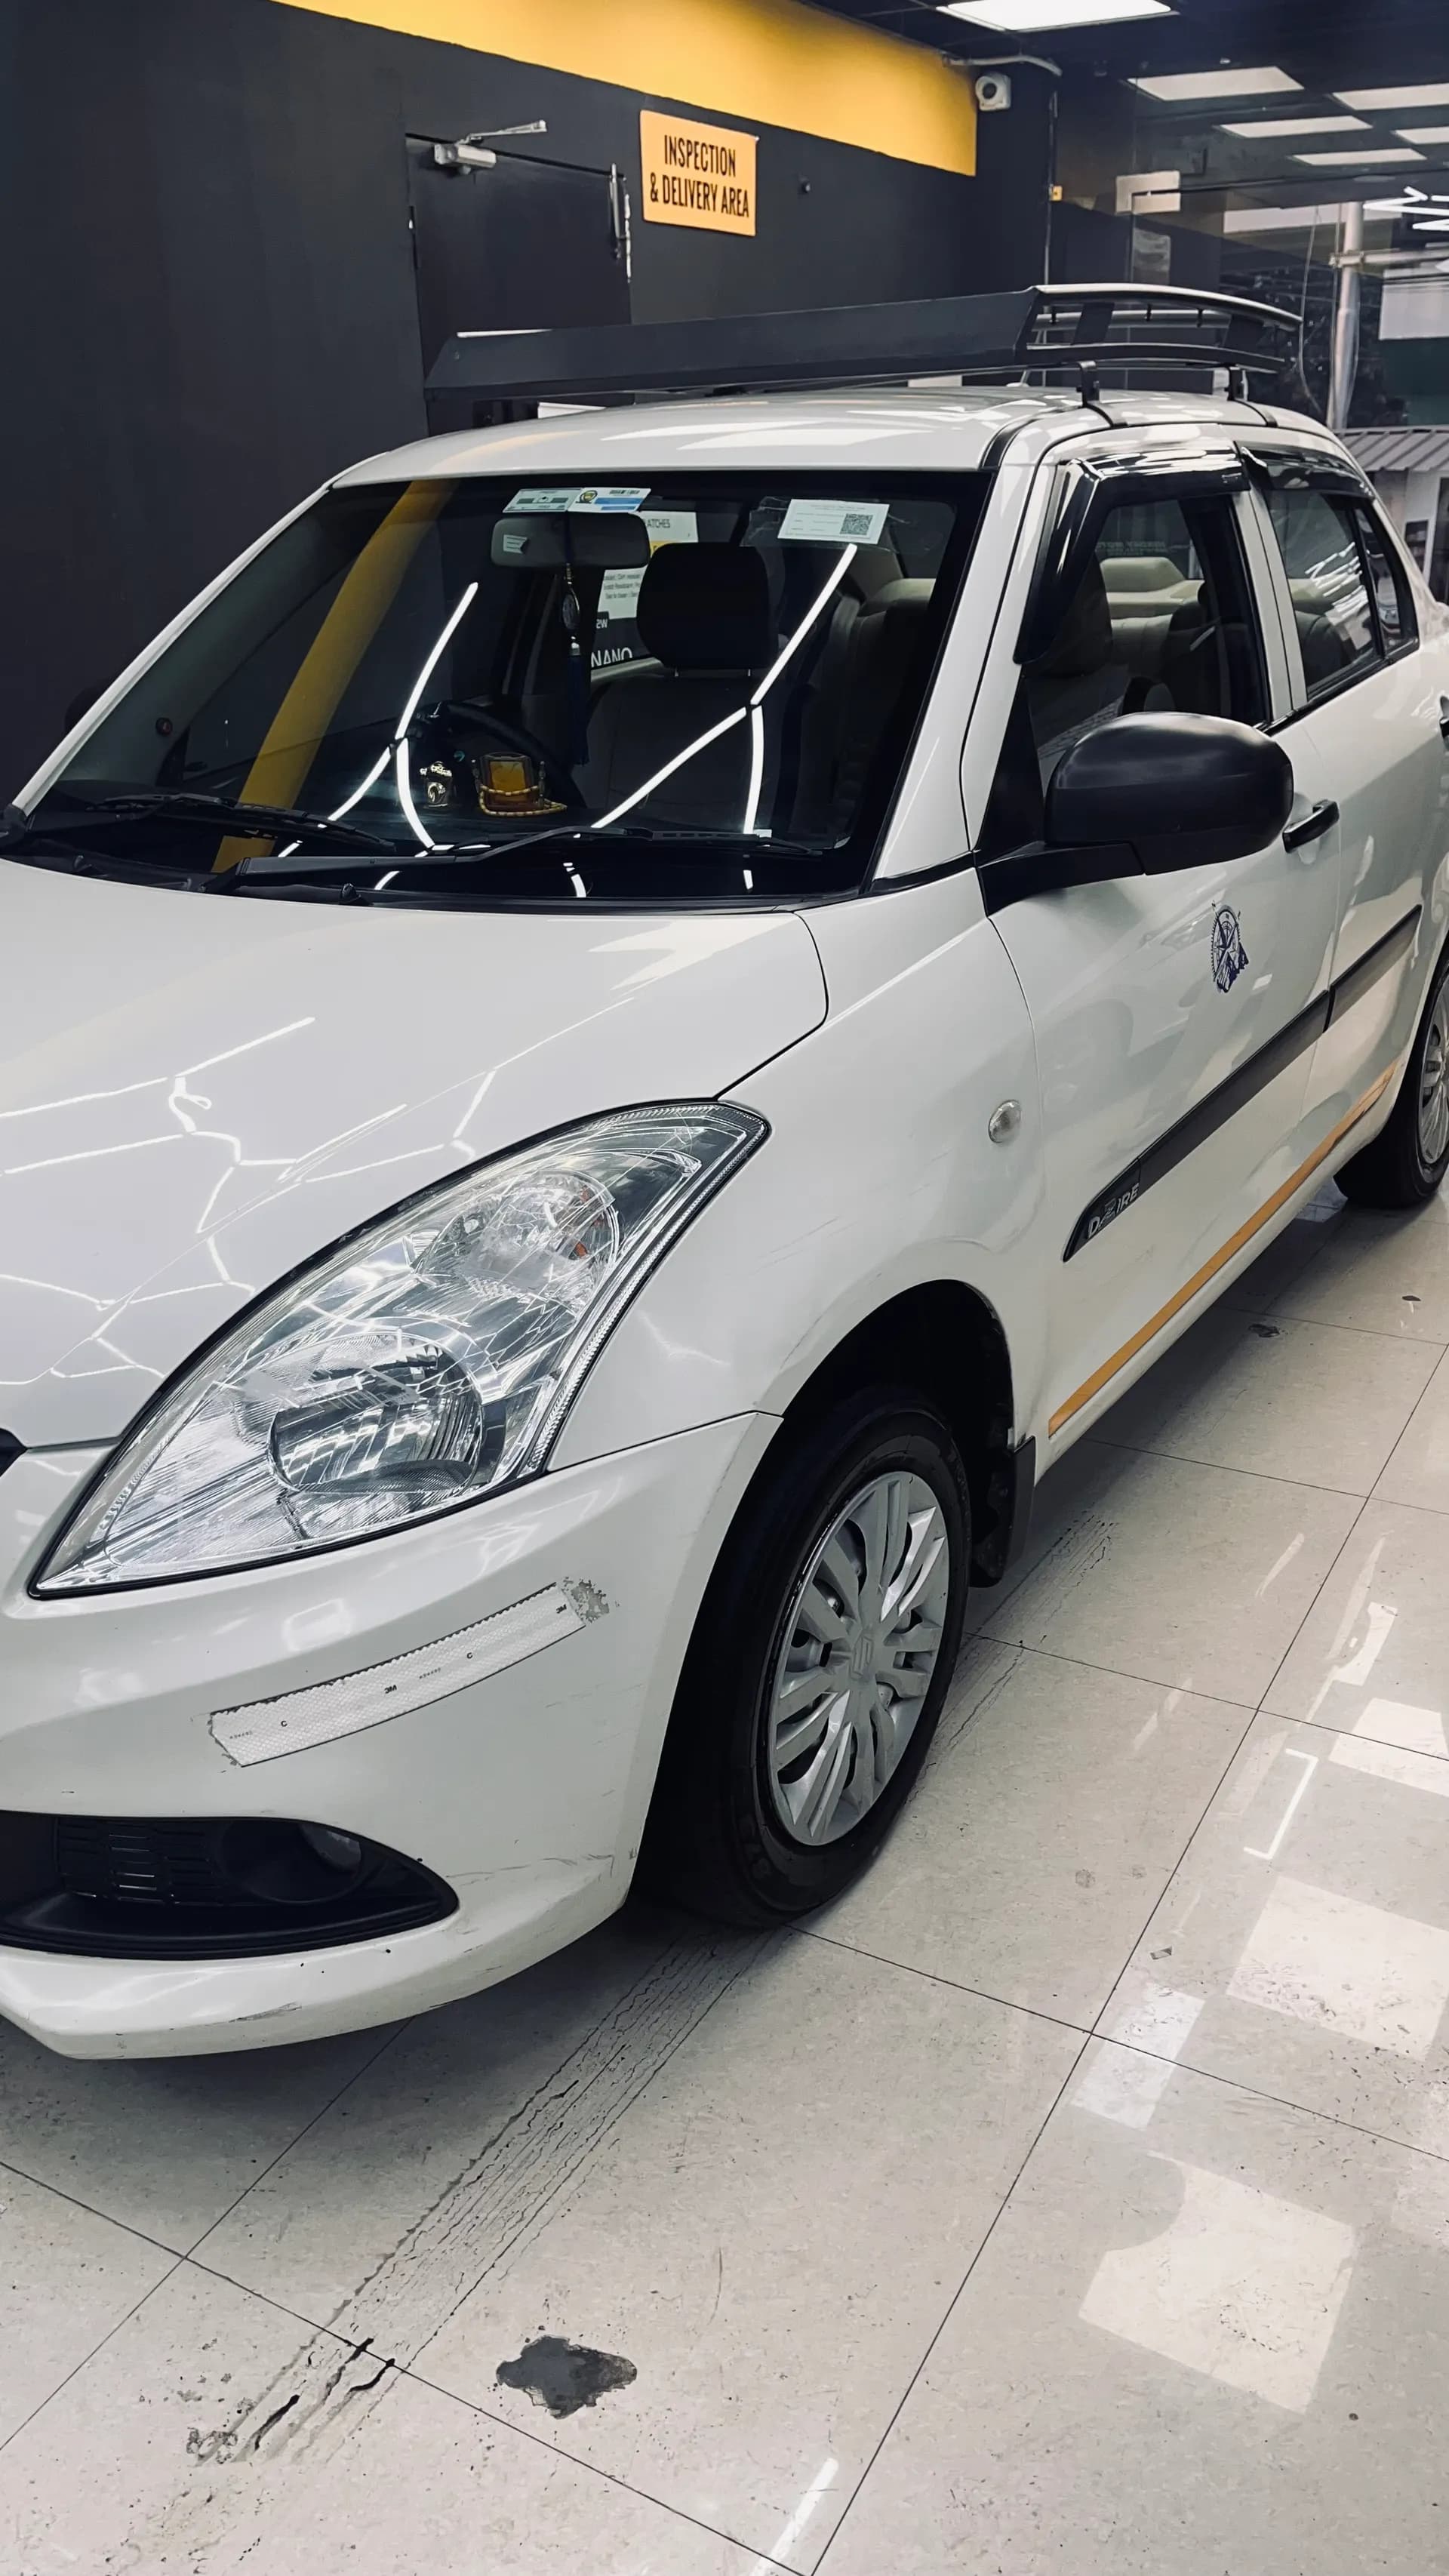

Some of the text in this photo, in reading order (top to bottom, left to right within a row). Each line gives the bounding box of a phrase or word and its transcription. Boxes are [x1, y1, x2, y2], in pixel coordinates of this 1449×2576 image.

[664, 134, 737, 178] INSPECTION
[650, 172, 749, 217] & DELIVERY AREA
[646, 519, 671, 528] ATCHES
[590, 647, 633, 668] NANO
[383, 1684, 398, 1694] 3M
